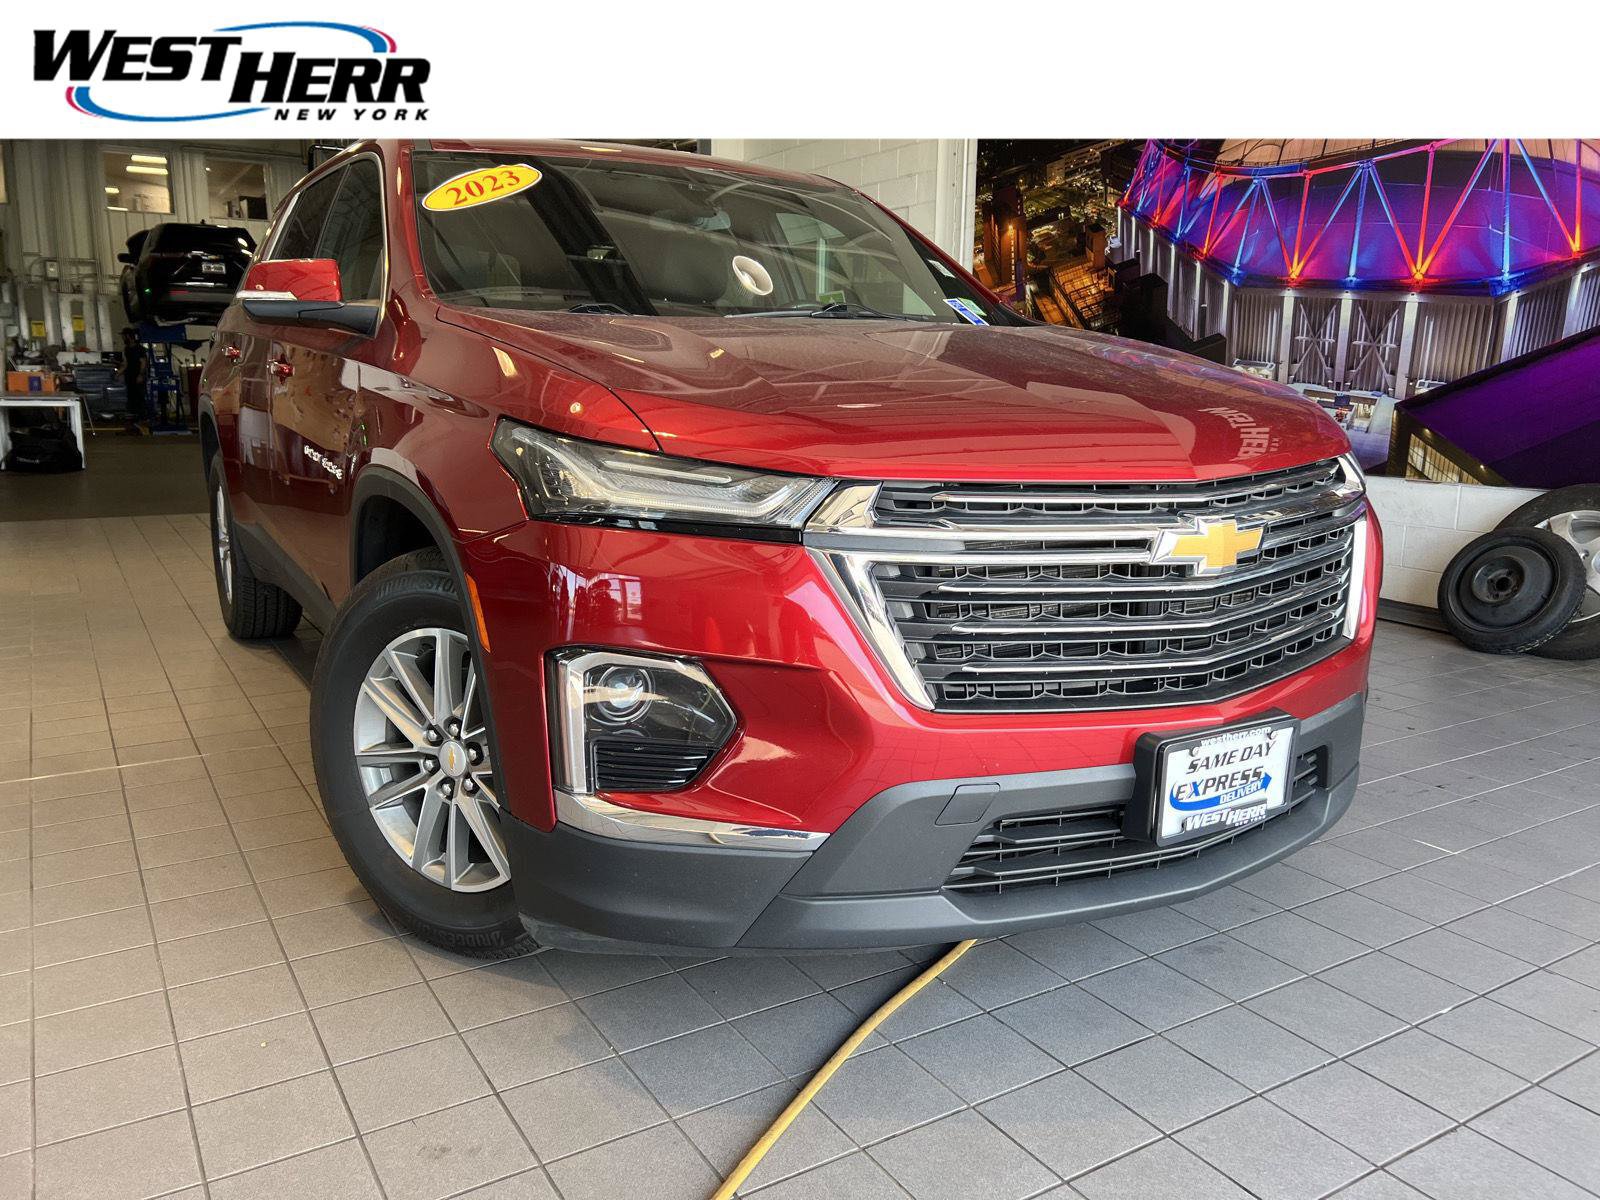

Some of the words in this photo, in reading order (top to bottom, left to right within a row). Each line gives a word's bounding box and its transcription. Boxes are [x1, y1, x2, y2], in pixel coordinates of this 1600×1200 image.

[445, 170, 521, 206] 2023
[1200, 727, 1272, 747] westherr.com
[1186, 749, 1239, 775] SAME
[1239, 741, 1277, 763] DAY
[1175, 766, 1264, 801] EXPRESS
[1220, 779, 1263, 803] DELIVERY
[1185, 807, 1232, 831] WEST
[1225, 804, 1268, 825] HERR
